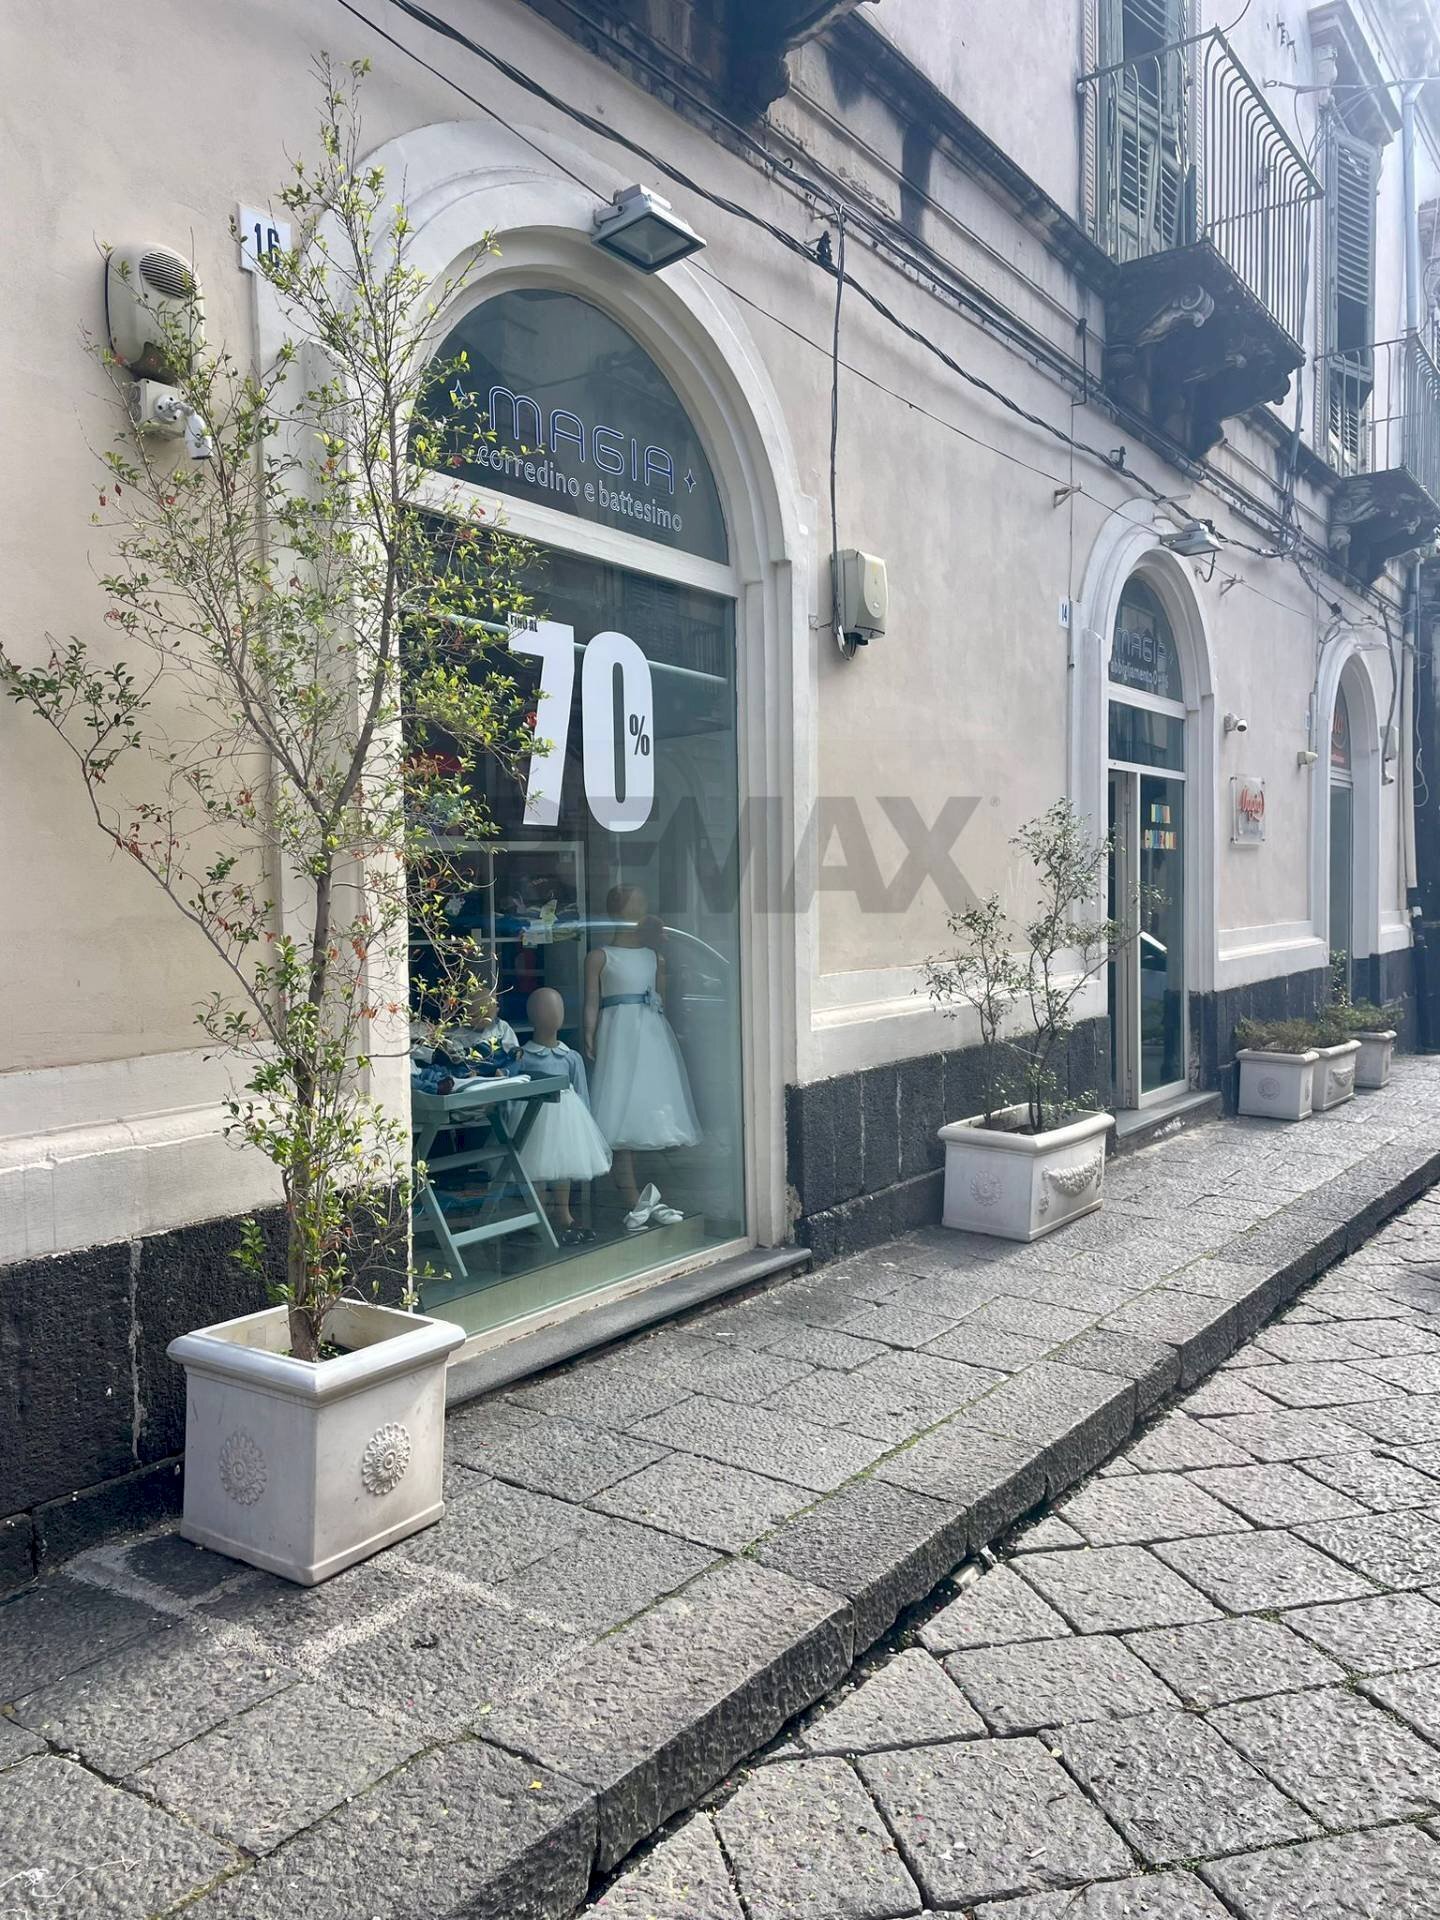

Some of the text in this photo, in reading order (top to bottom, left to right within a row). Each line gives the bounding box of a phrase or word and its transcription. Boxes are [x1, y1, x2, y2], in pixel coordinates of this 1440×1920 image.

[254, 222, 280, 271] 16
[489, 385, 675, 495] MAGIA
[477, 445, 683, 532] corredino e battesimo
[1061, 603, 1068, 622] 14
[1115, 627, 1169, 666] MAGIA
